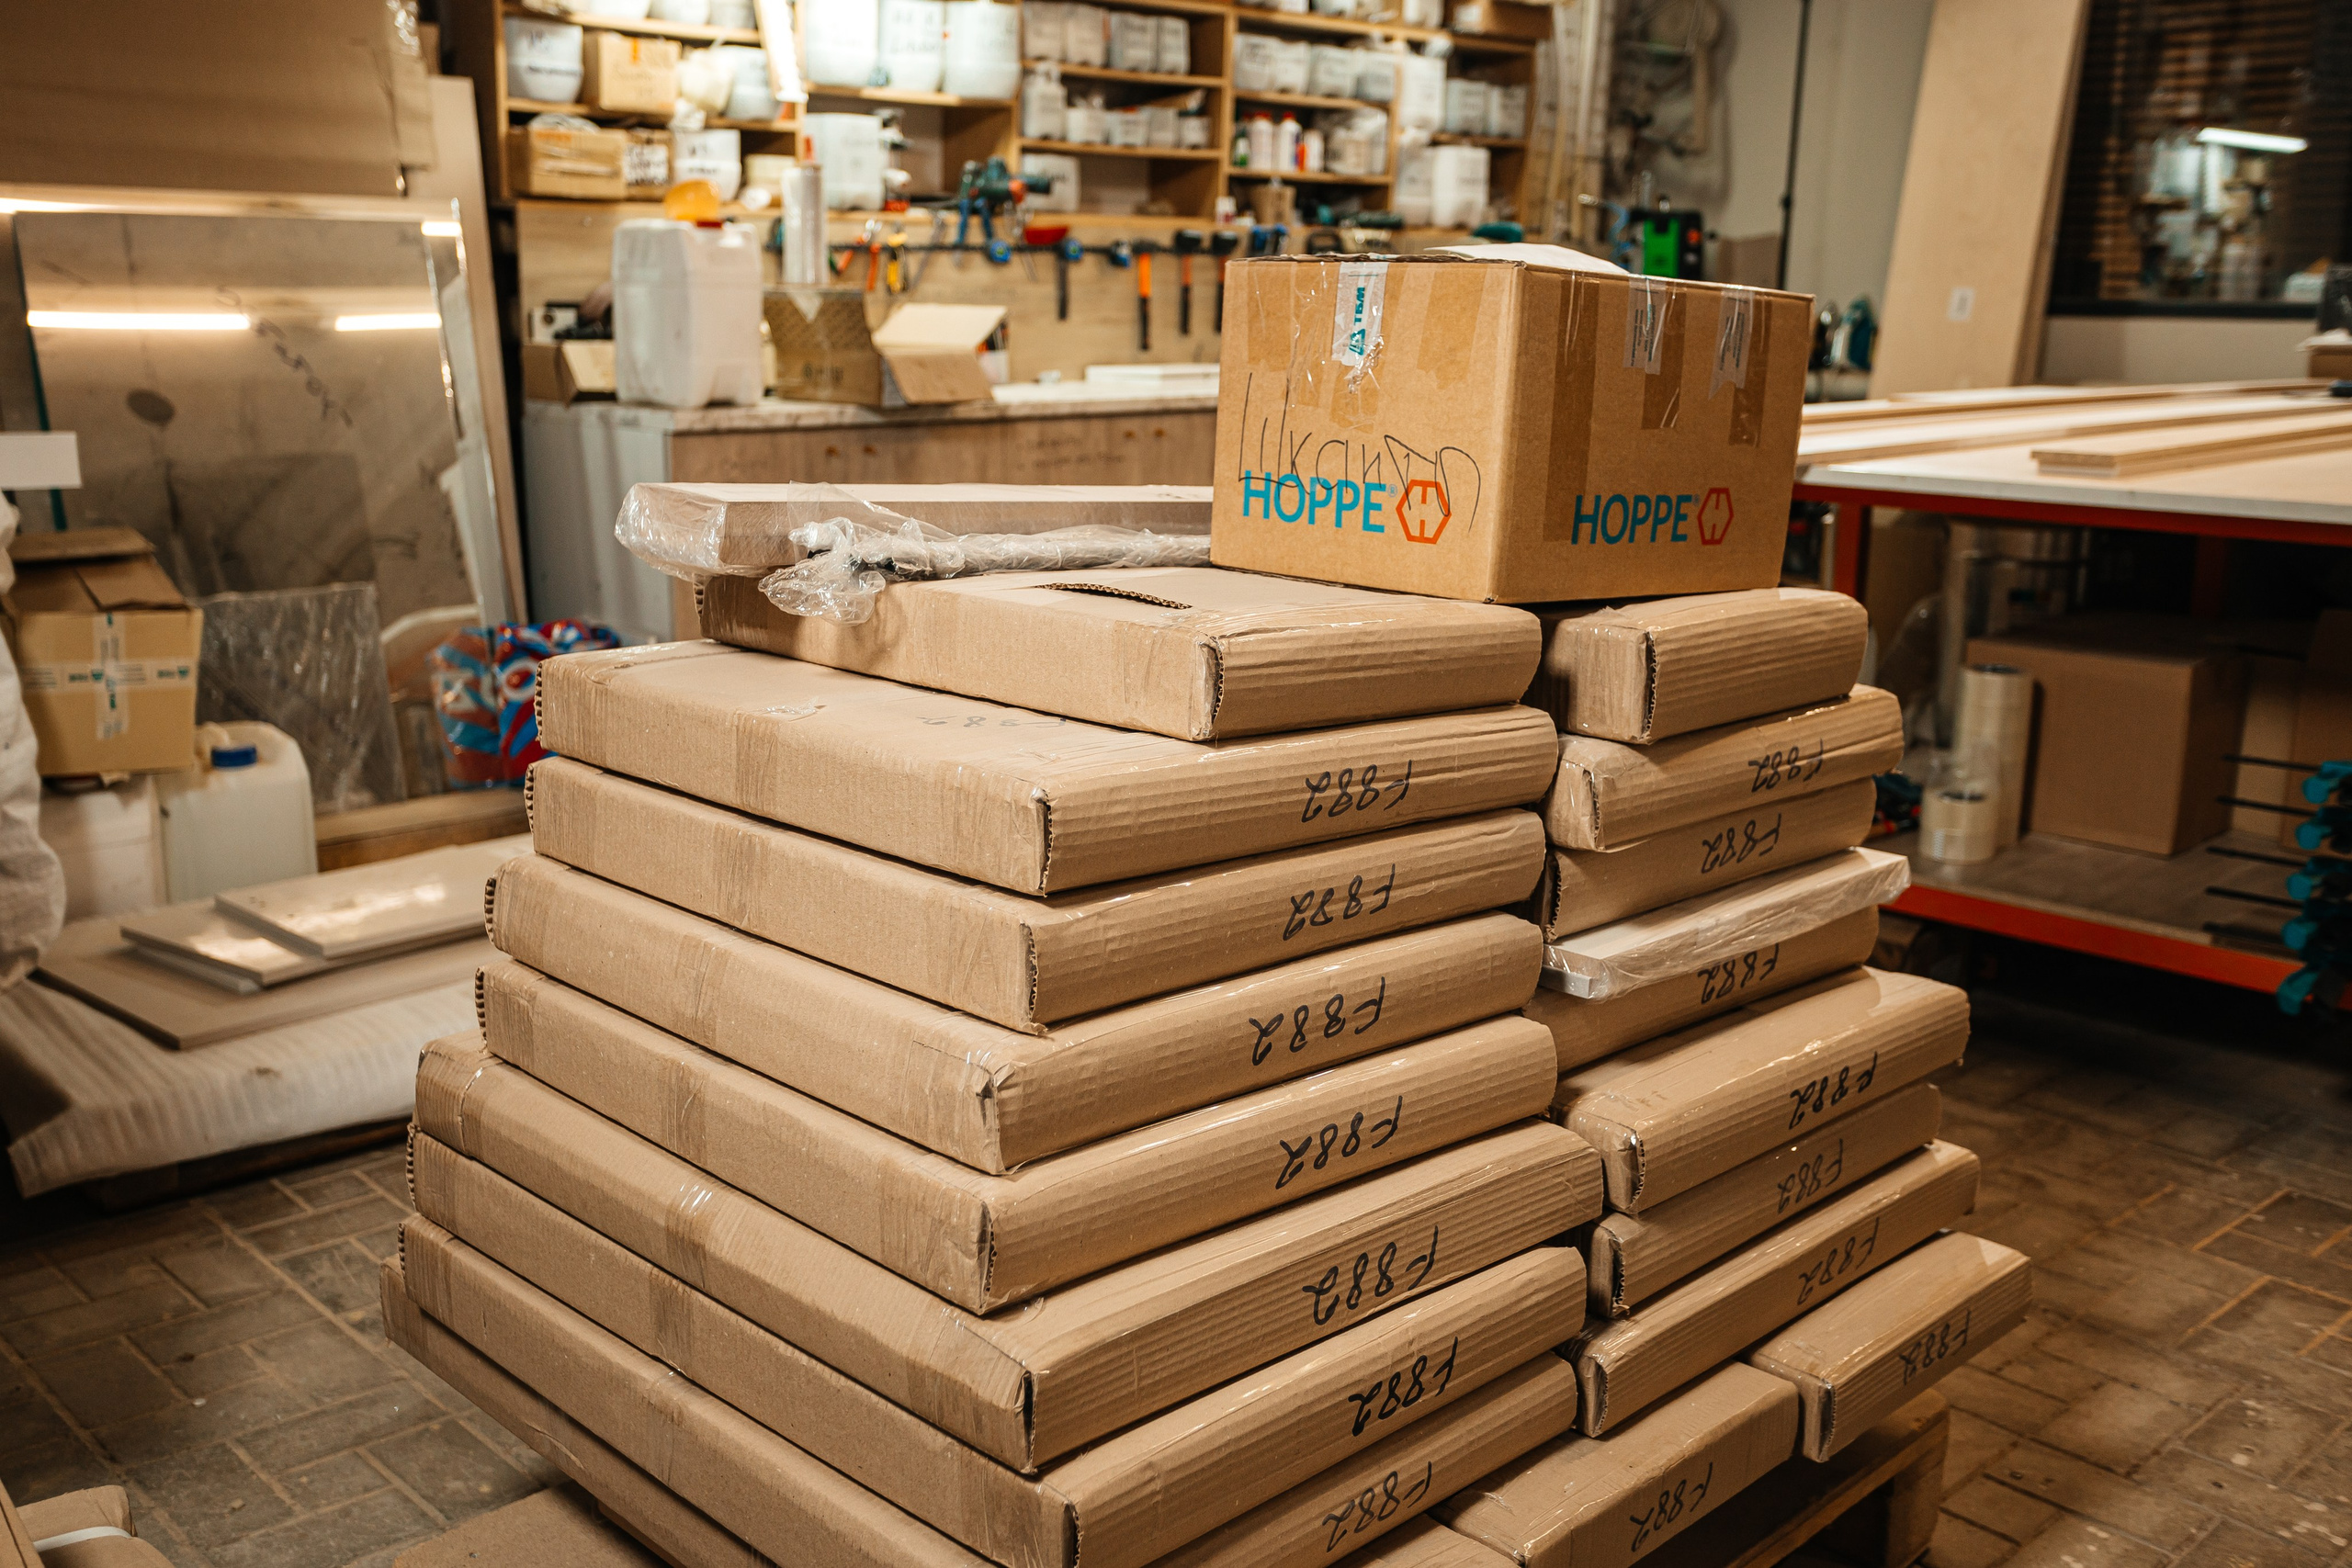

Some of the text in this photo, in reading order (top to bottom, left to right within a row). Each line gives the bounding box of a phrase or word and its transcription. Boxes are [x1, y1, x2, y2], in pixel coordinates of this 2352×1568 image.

[1243, 469, 1386, 534] HOPPE
[1571, 494, 1692, 545] HOPPE
[1303, 761, 1413, 823] F882
[1748, 738, 1826, 794] F882
[1702, 813, 1783, 874] F882
[1283, 863, 1396, 941] F882
[1250, 976, 1385, 1066] F882
[1276, 1095, 1403, 1190] F882
[1303, 1225, 1439, 1325] F882
[1797, 1217, 1879, 1305] F882
[1349, 1337, 1459, 1437] F882
[1324, 1461, 1434, 1554] F882
[1630, 1461, 1713, 1553] F882
